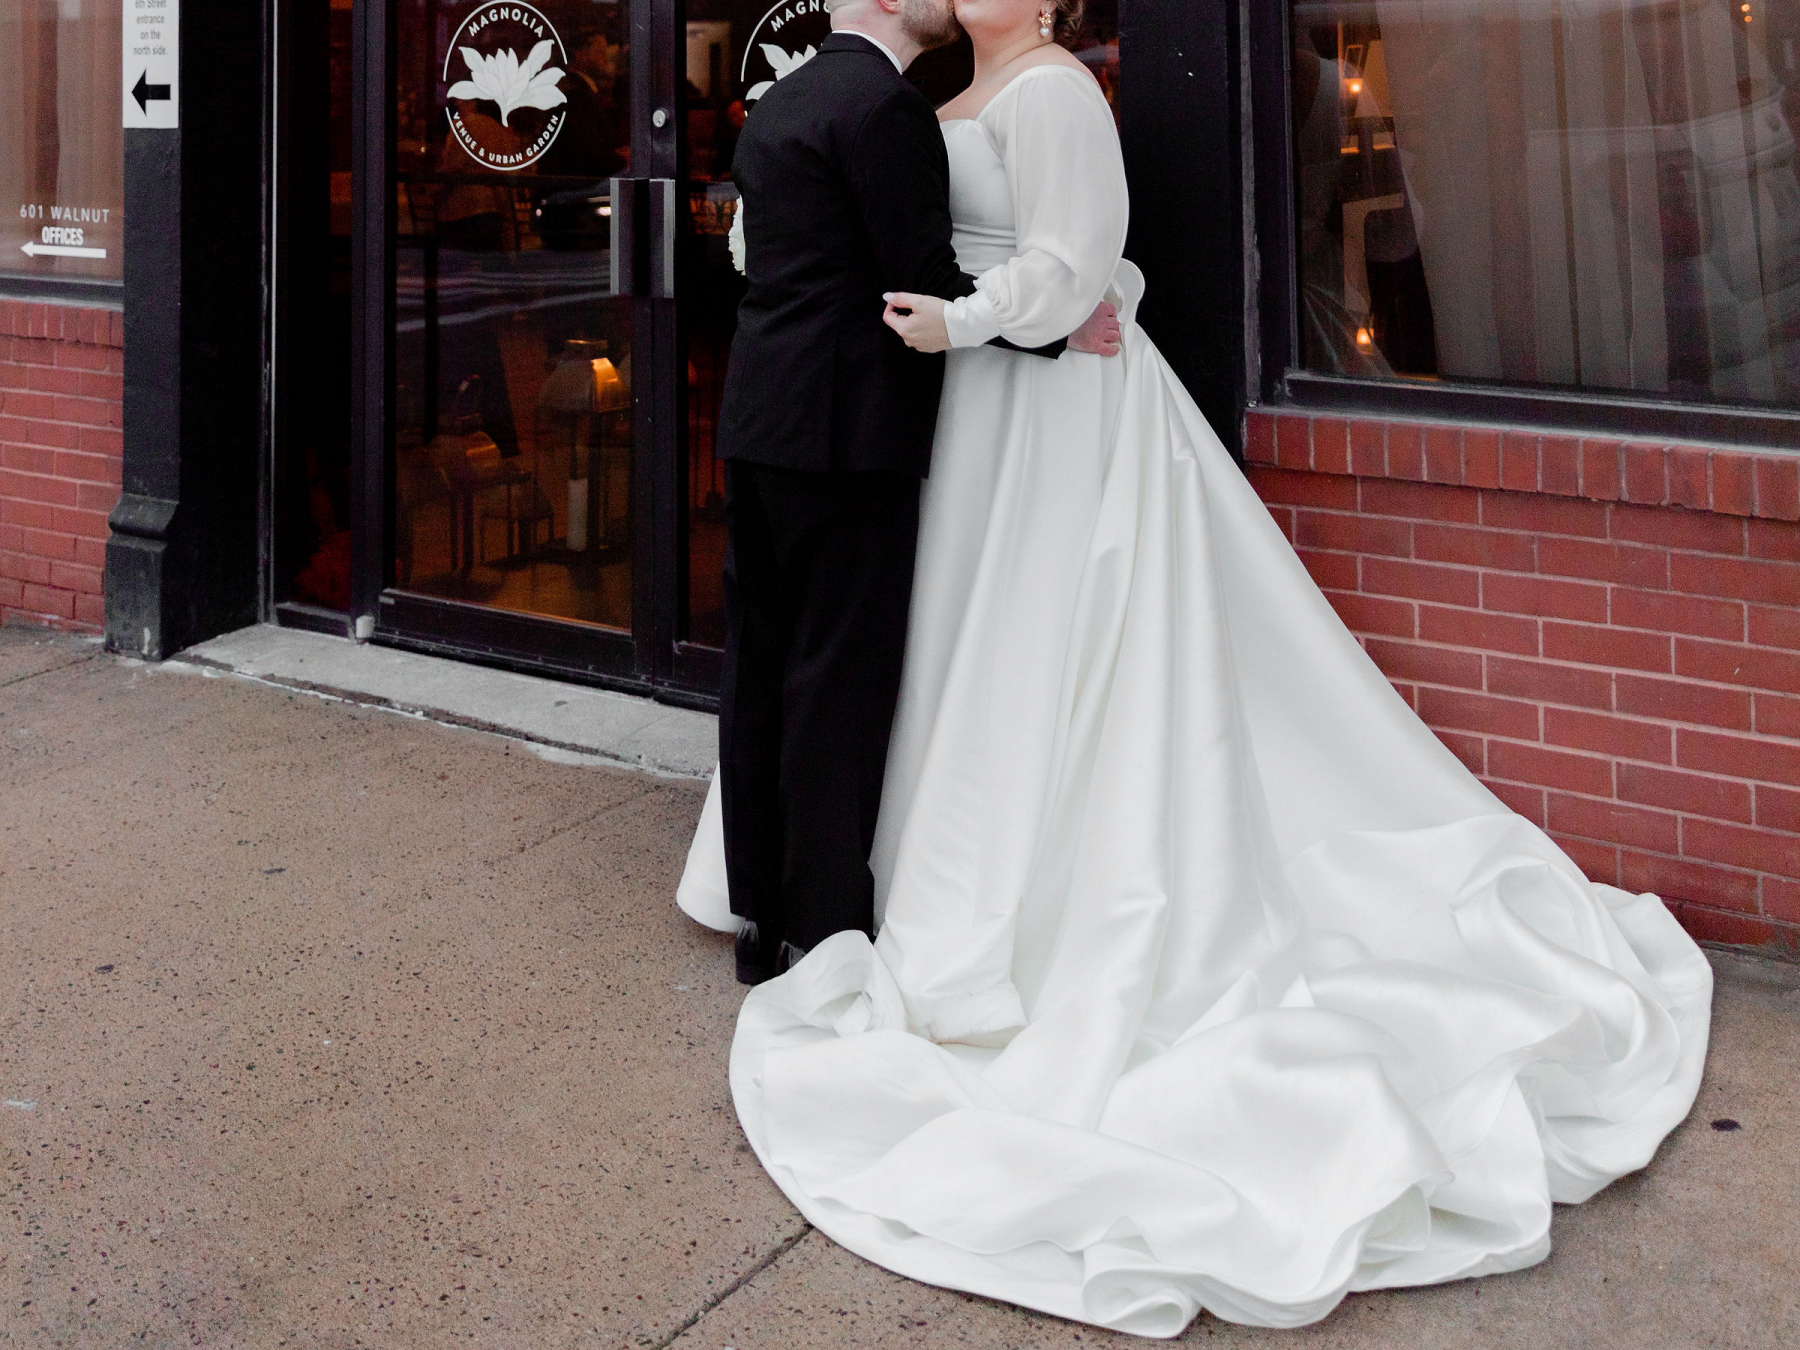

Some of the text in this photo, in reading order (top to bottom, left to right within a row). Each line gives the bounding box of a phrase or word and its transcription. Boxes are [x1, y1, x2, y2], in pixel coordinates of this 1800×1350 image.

[136, 14, 165, 25] entrance
[468, 7, 544, 38] MAGNOLIA
[140, 28, 161, 40] on the
[132, 44, 151, 56] north
[453, 111, 559, 164] VENUE & URBAN GARDEN
[20, 204, 110, 223] 601 WALNUT
[41, 226, 84, 247] OFFICES
